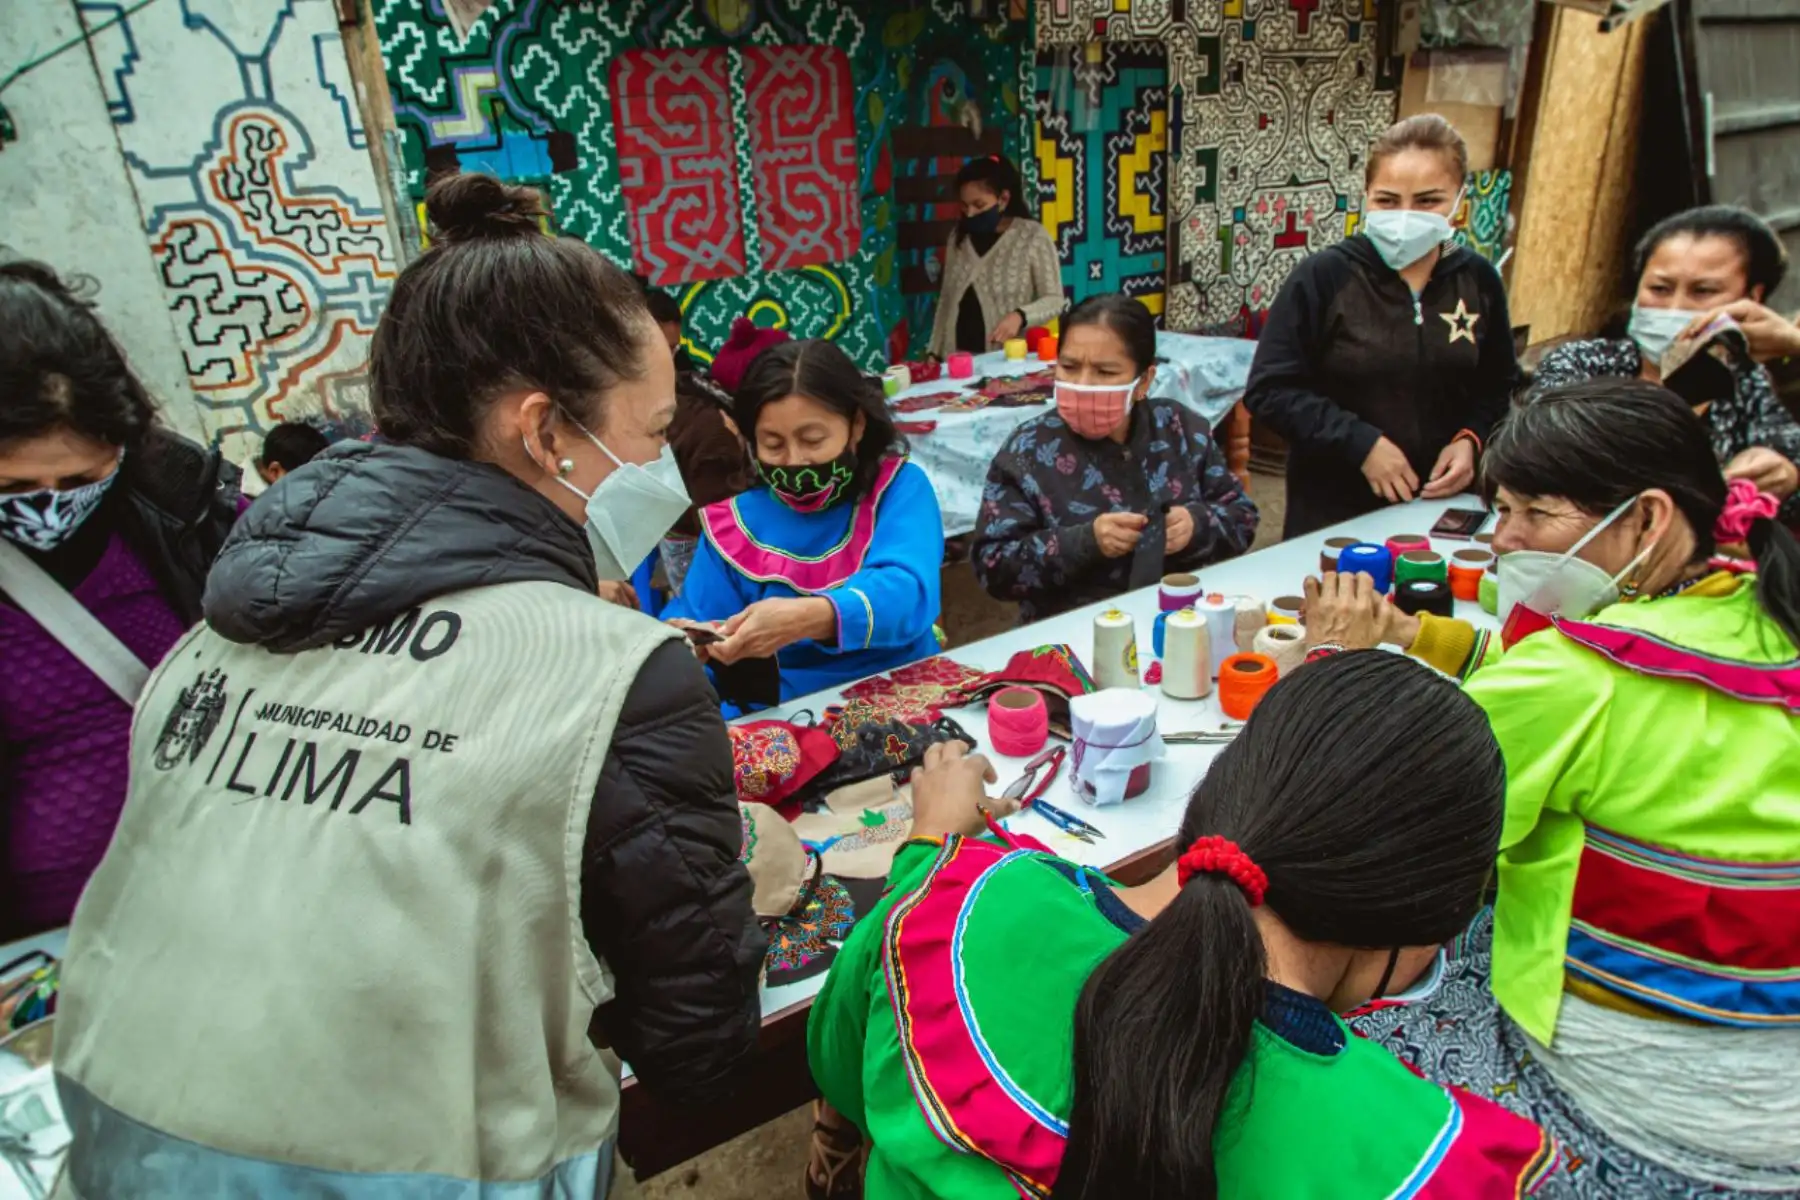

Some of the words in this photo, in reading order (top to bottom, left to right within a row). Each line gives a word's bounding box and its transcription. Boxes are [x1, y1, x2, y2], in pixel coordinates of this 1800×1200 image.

[256, 702, 411, 743] MUNICIPALIDAD
[422, 730, 459, 752] DE
[226, 732, 411, 826] LIMA
